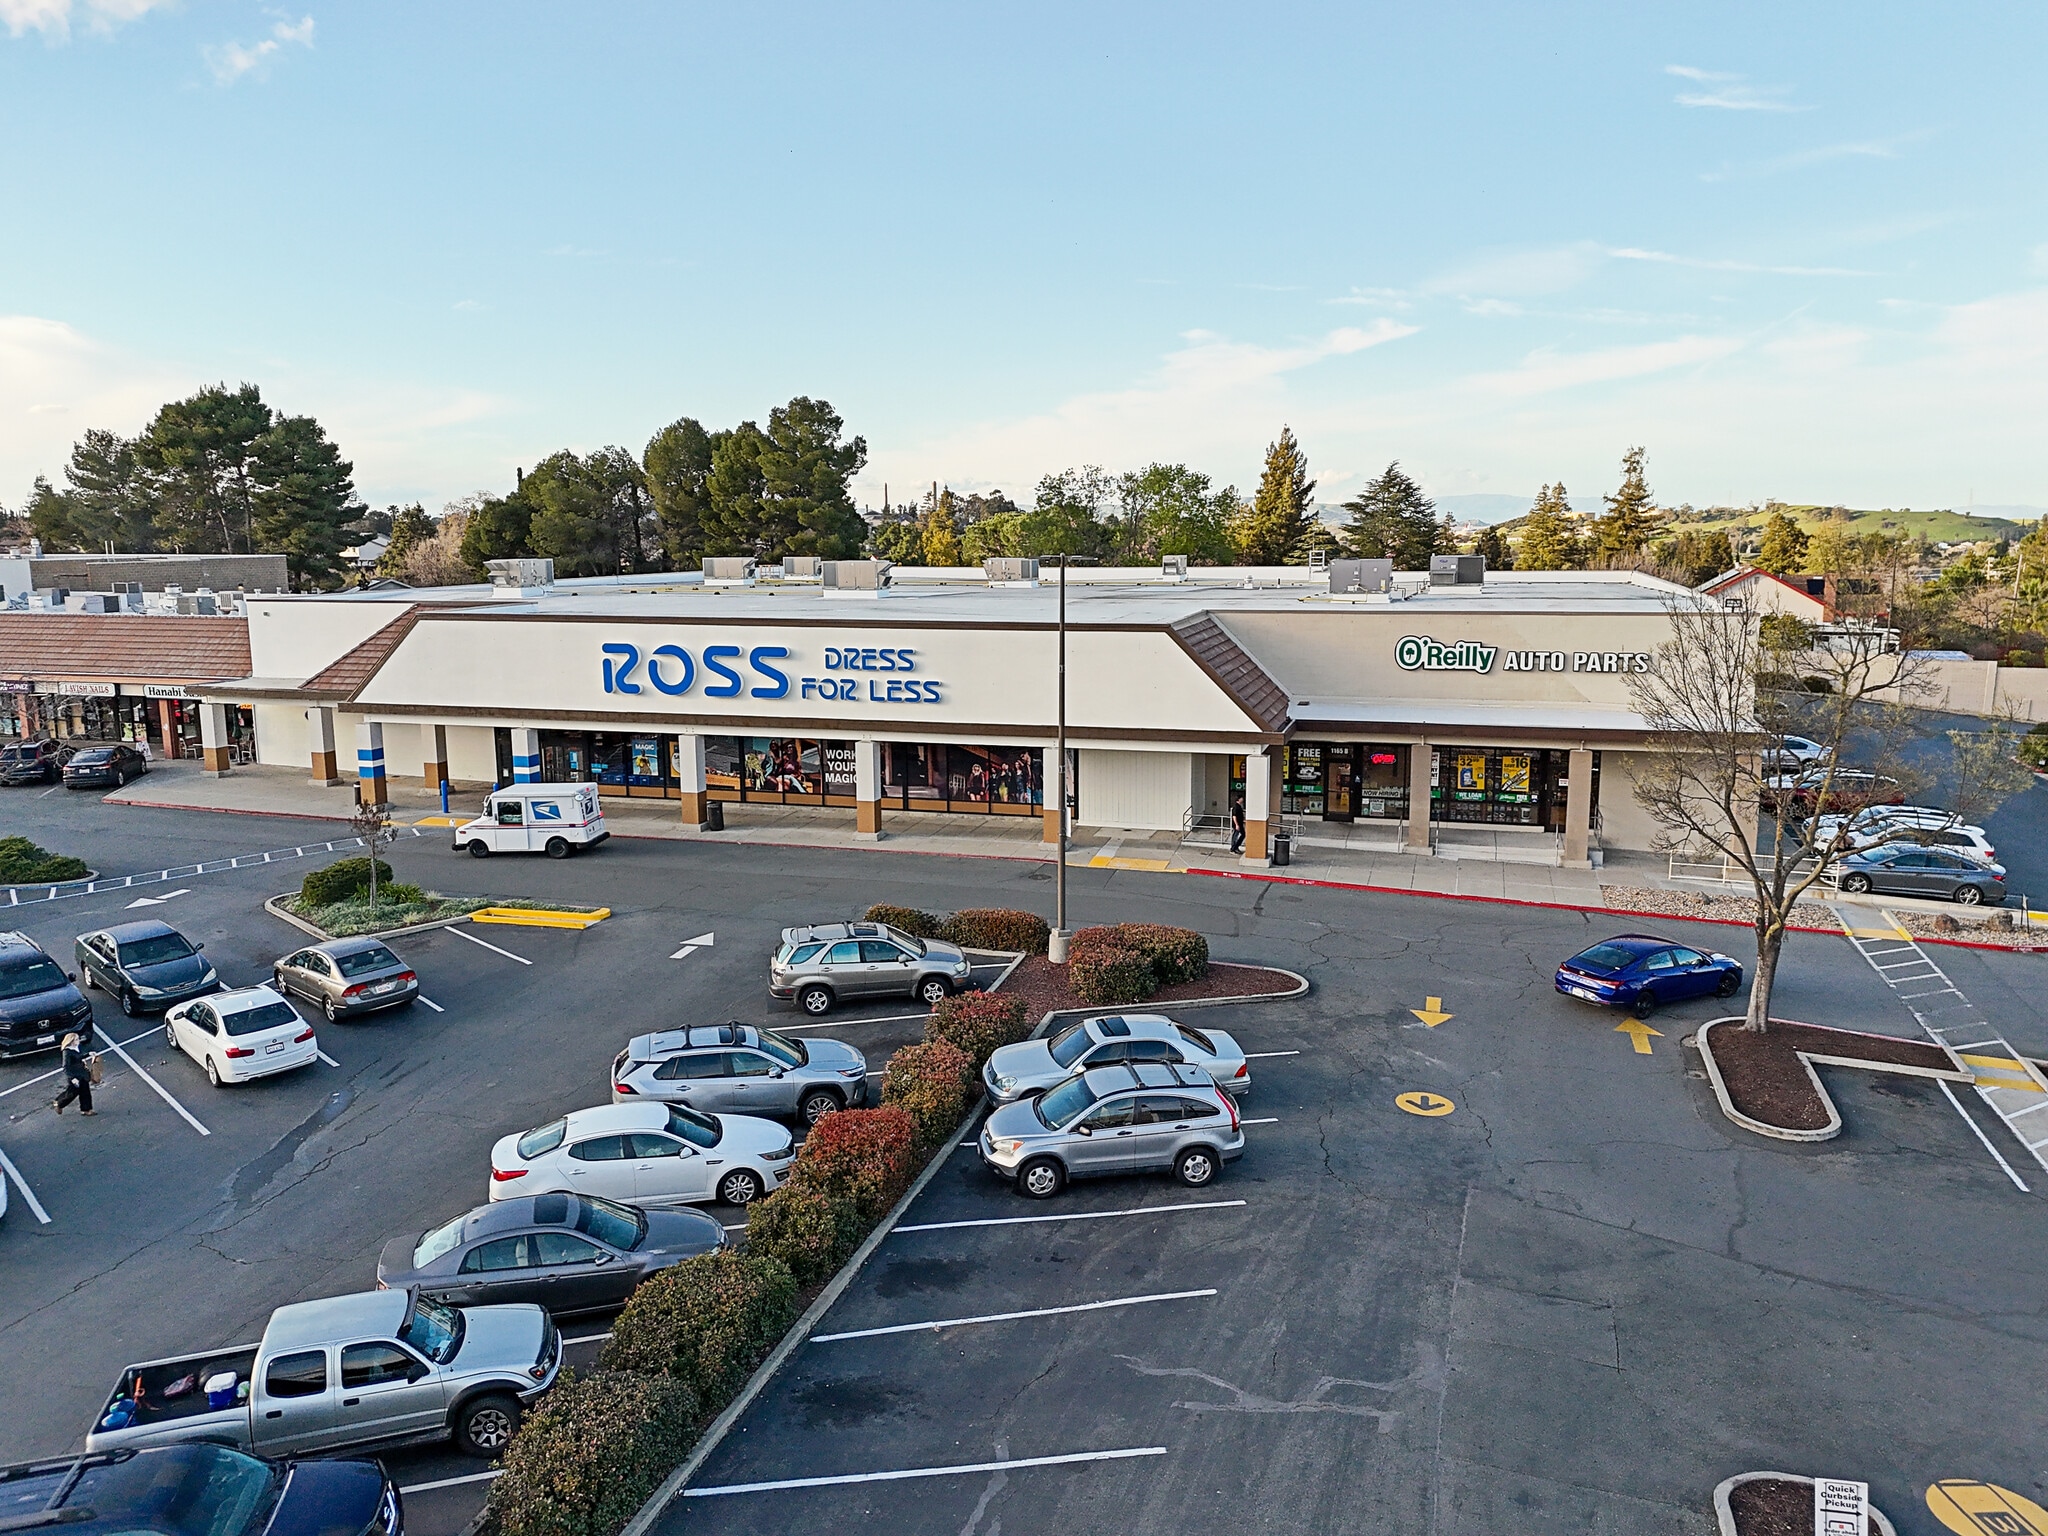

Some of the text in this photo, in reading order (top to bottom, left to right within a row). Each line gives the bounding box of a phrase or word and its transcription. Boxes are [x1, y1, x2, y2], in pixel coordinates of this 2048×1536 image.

[825, 647, 916, 672] DRESS
[1399, 638, 1649, 673] O'Reilly AUTO PARTS
[601, 642, 790, 699] ROSS
[89, 686, 110, 694] NAILS
[148, 686, 181, 697] Hanabi
[801, 677, 942, 703] FOR LESS
[635, 743, 654, 751] MAGIC
[1298, 747, 1320, 757] FREE
[827, 761, 857, 772] YOUR
[825, 772, 858, 784] MAGIC
[1828, 1485, 1855, 1493] Quick
[1820, 1491, 1863, 1502] Curbside
[1825, 1500, 1858, 1510] Pickup
